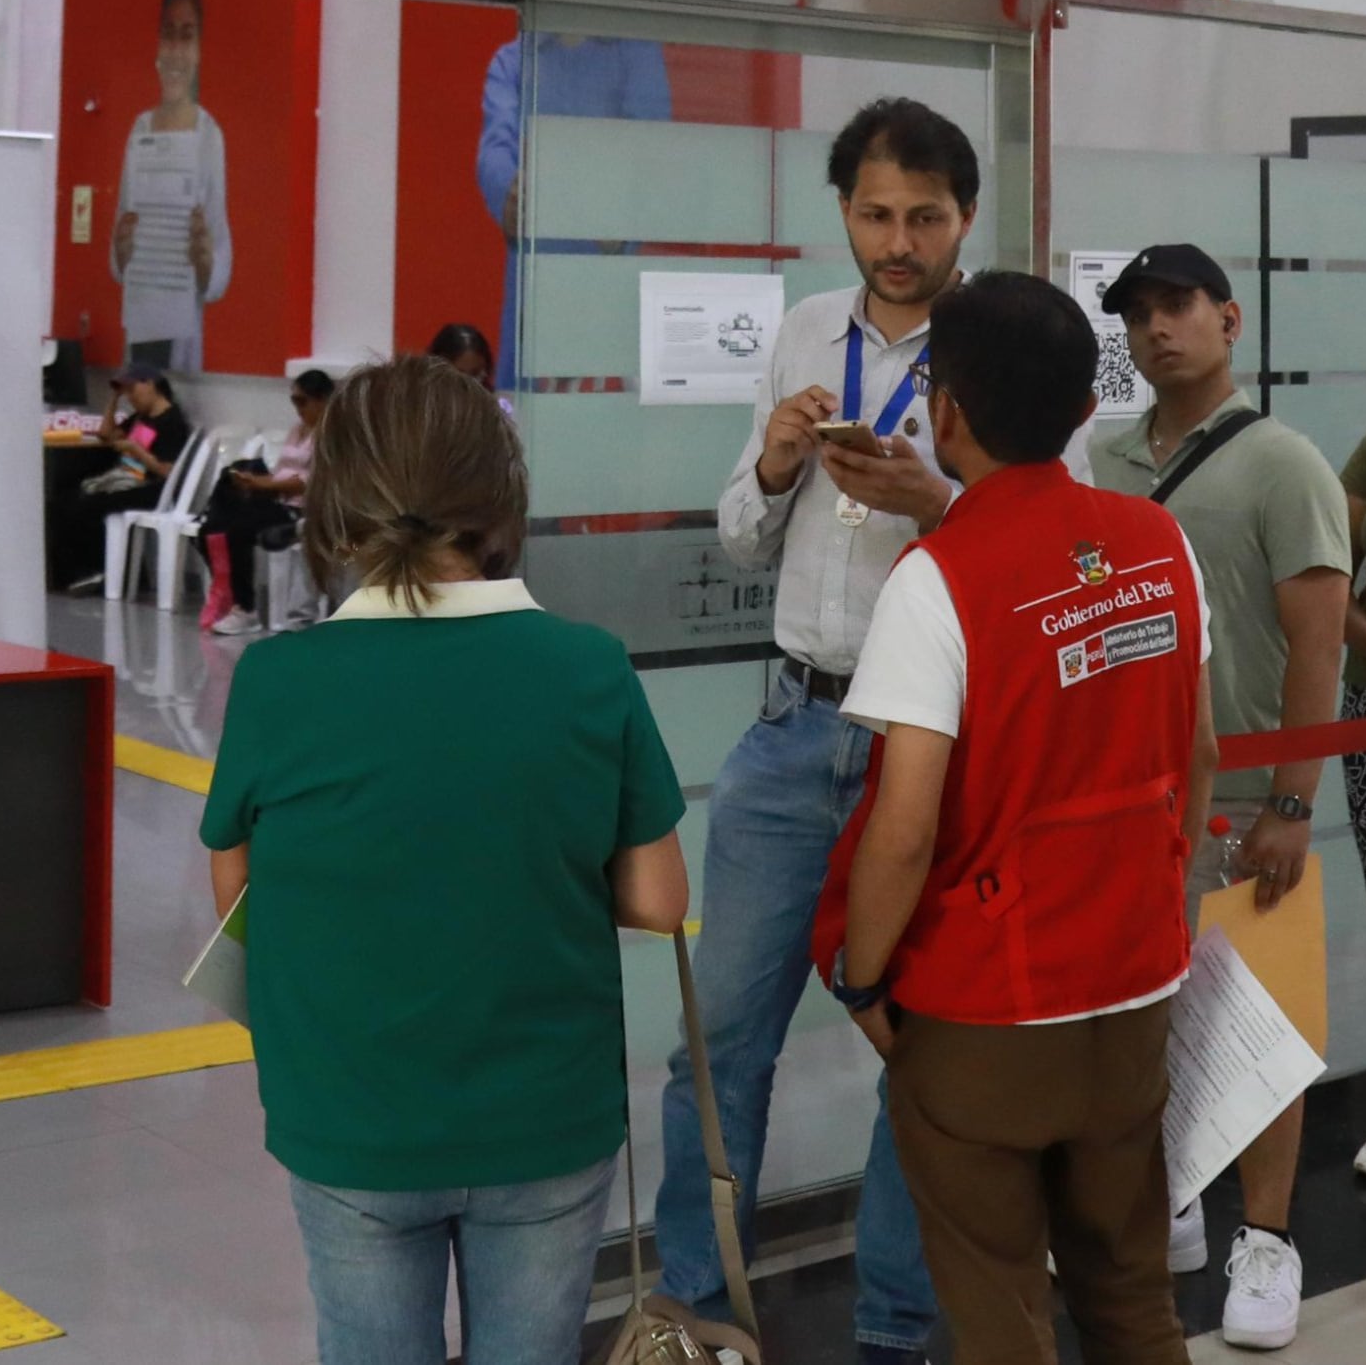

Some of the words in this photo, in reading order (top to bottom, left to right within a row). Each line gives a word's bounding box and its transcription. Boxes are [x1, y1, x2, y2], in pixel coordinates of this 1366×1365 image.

[1041, 600, 1114, 636] Gobierno
[1115, 585, 1142, 609] del
[1142, 576, 1174, 602] Perú
[1136, 625, 1147, 638] de
